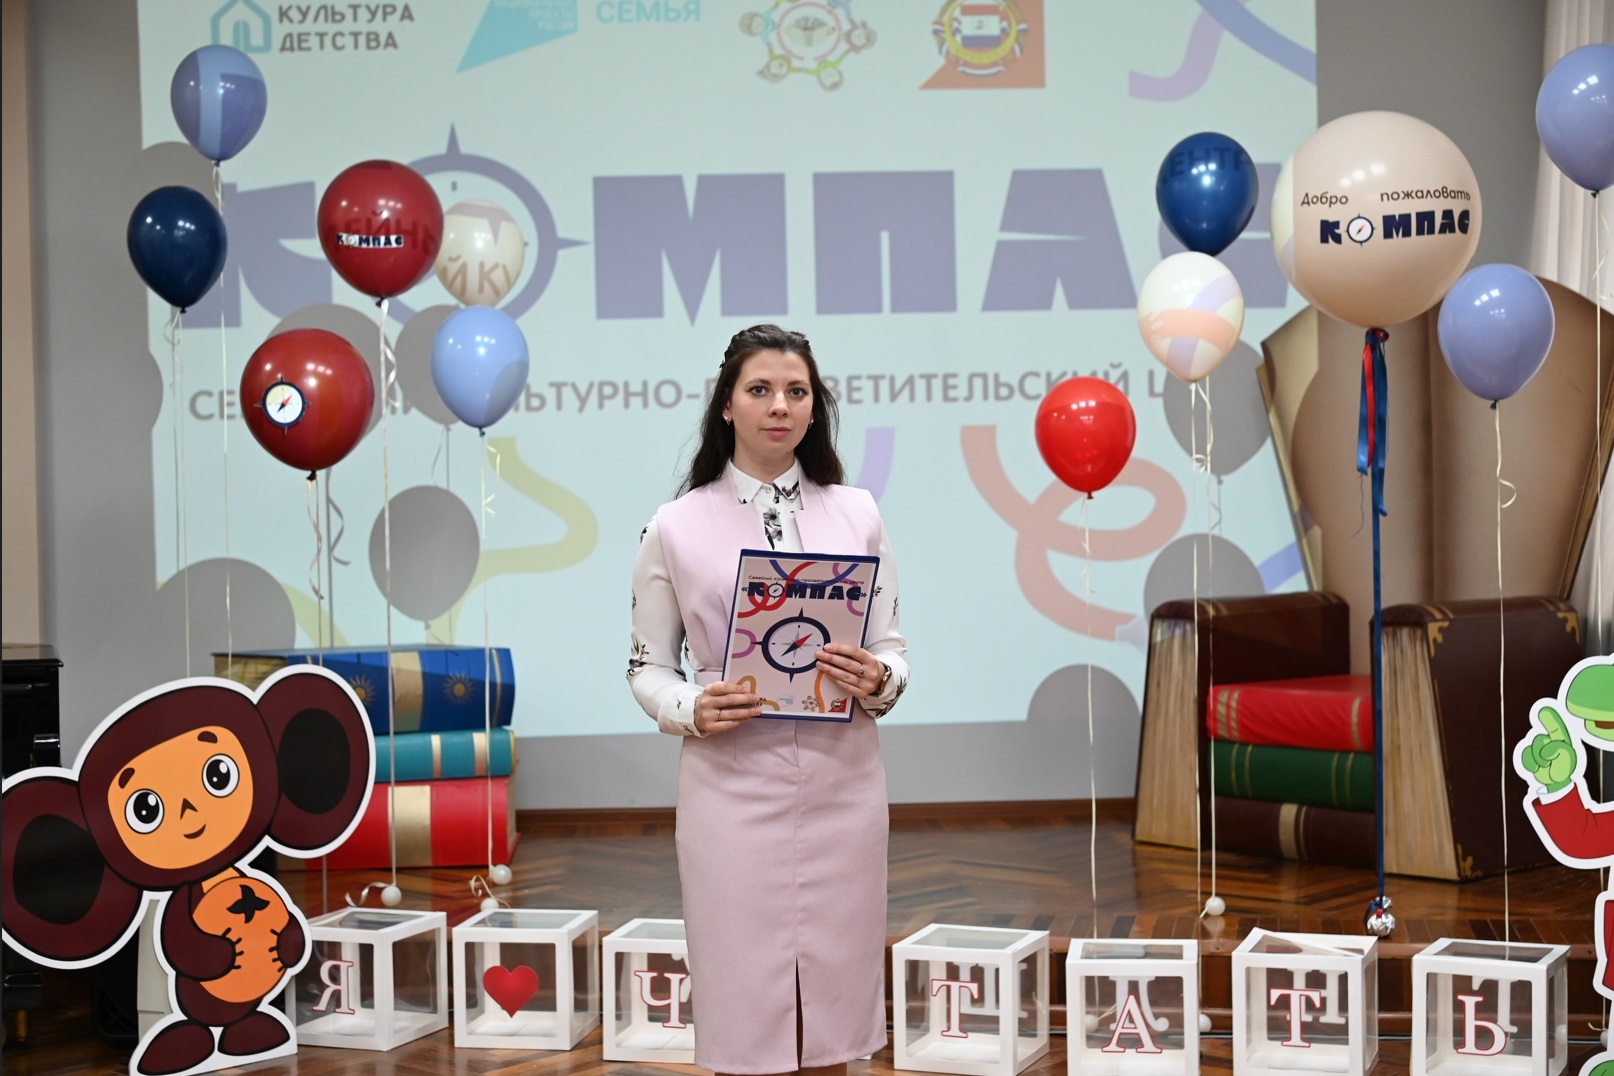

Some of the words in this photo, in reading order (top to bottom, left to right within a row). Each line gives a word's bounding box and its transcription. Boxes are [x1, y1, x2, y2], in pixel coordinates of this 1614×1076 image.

[278, 4, 414, 24] КУЛЬТУРА
[596, 0, 703, 23] СЕМЬЯ
[279, 31, 399, 53] ДЕТСТВА
[1301, 192, 1349, 208] Добро
[1380, 186, 1471, 202] пожаловать
[336, 233, 404, 248] КОМПАС
[312, 959, 355, 1015] Я
